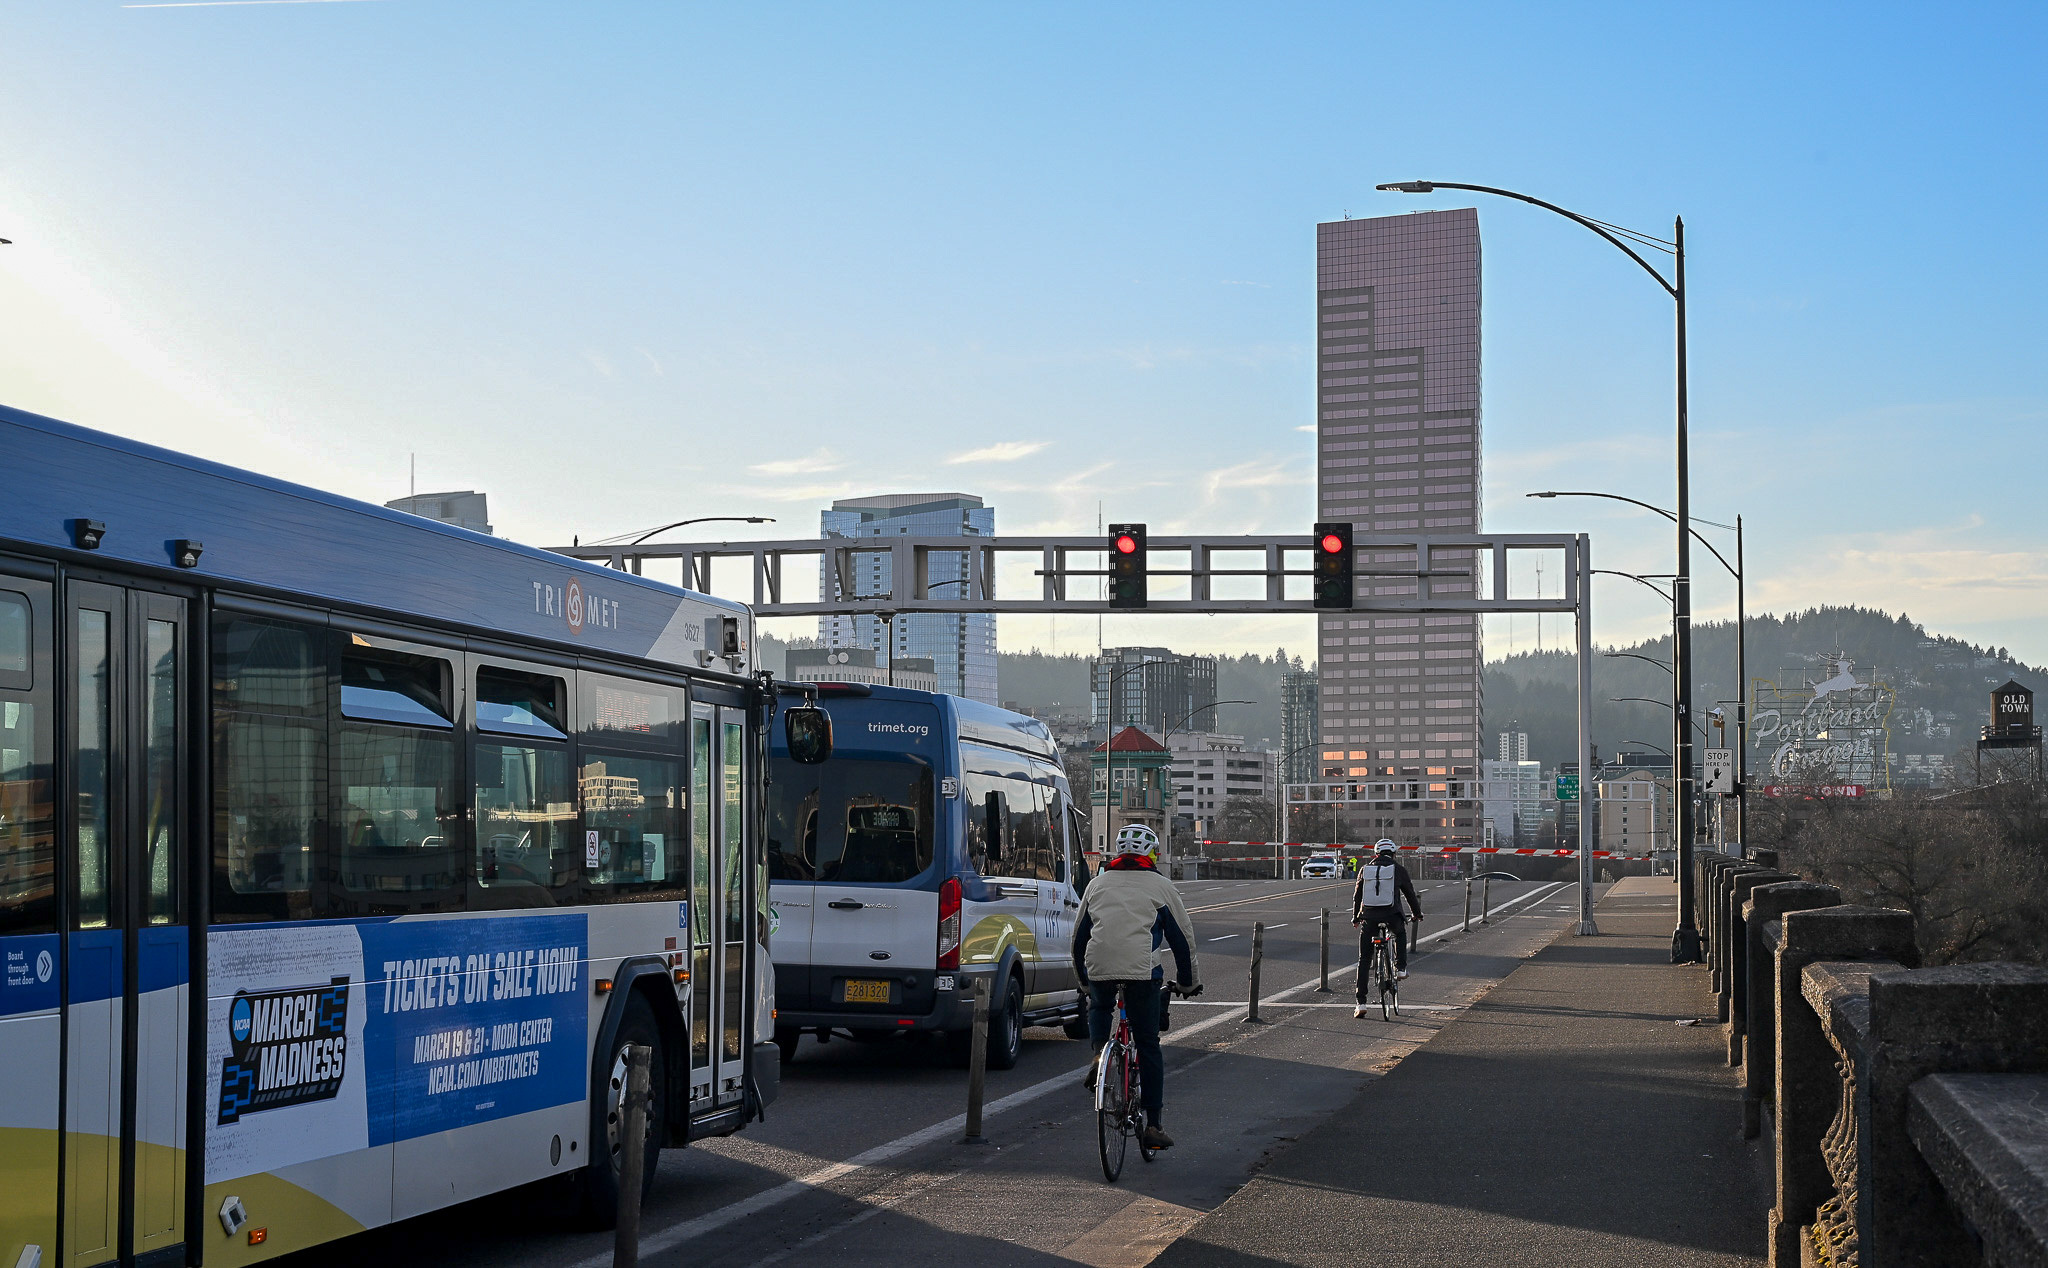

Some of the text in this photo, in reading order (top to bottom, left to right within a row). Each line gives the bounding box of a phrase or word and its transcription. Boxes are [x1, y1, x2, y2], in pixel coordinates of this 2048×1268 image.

[533, 581, 619, 630] TRI MET
[684, 622, 700, 642] 3627
[2003, 694, 2026, 704] OLD
[2000, 703, 2030, 713] TOWN
[1752, 690, 1882, 748] Portland
[868, 721, 929, 736] trimet.org
[1707, 752, 1729, 760] STOP
[8, 950, 24, 961] Board
[8, 962, 29, 975] through
[8, 975, 35, 986] front door
[383, 946, 579, 1014] TICKETS ON SALE NOW!
[847, 984, 888, 998] E281320
[234, 1018, 251, 1031] NCAA
[251, 993, 317, 1044] MARCH
[413, 1017, 553, 1064] MARCH 19 & 21 MODA CENTER
[258, 1036, 345, 1091] MADNESS
[428, 1050, 540, 1096] NCAA.COM/MBBTICKETS
